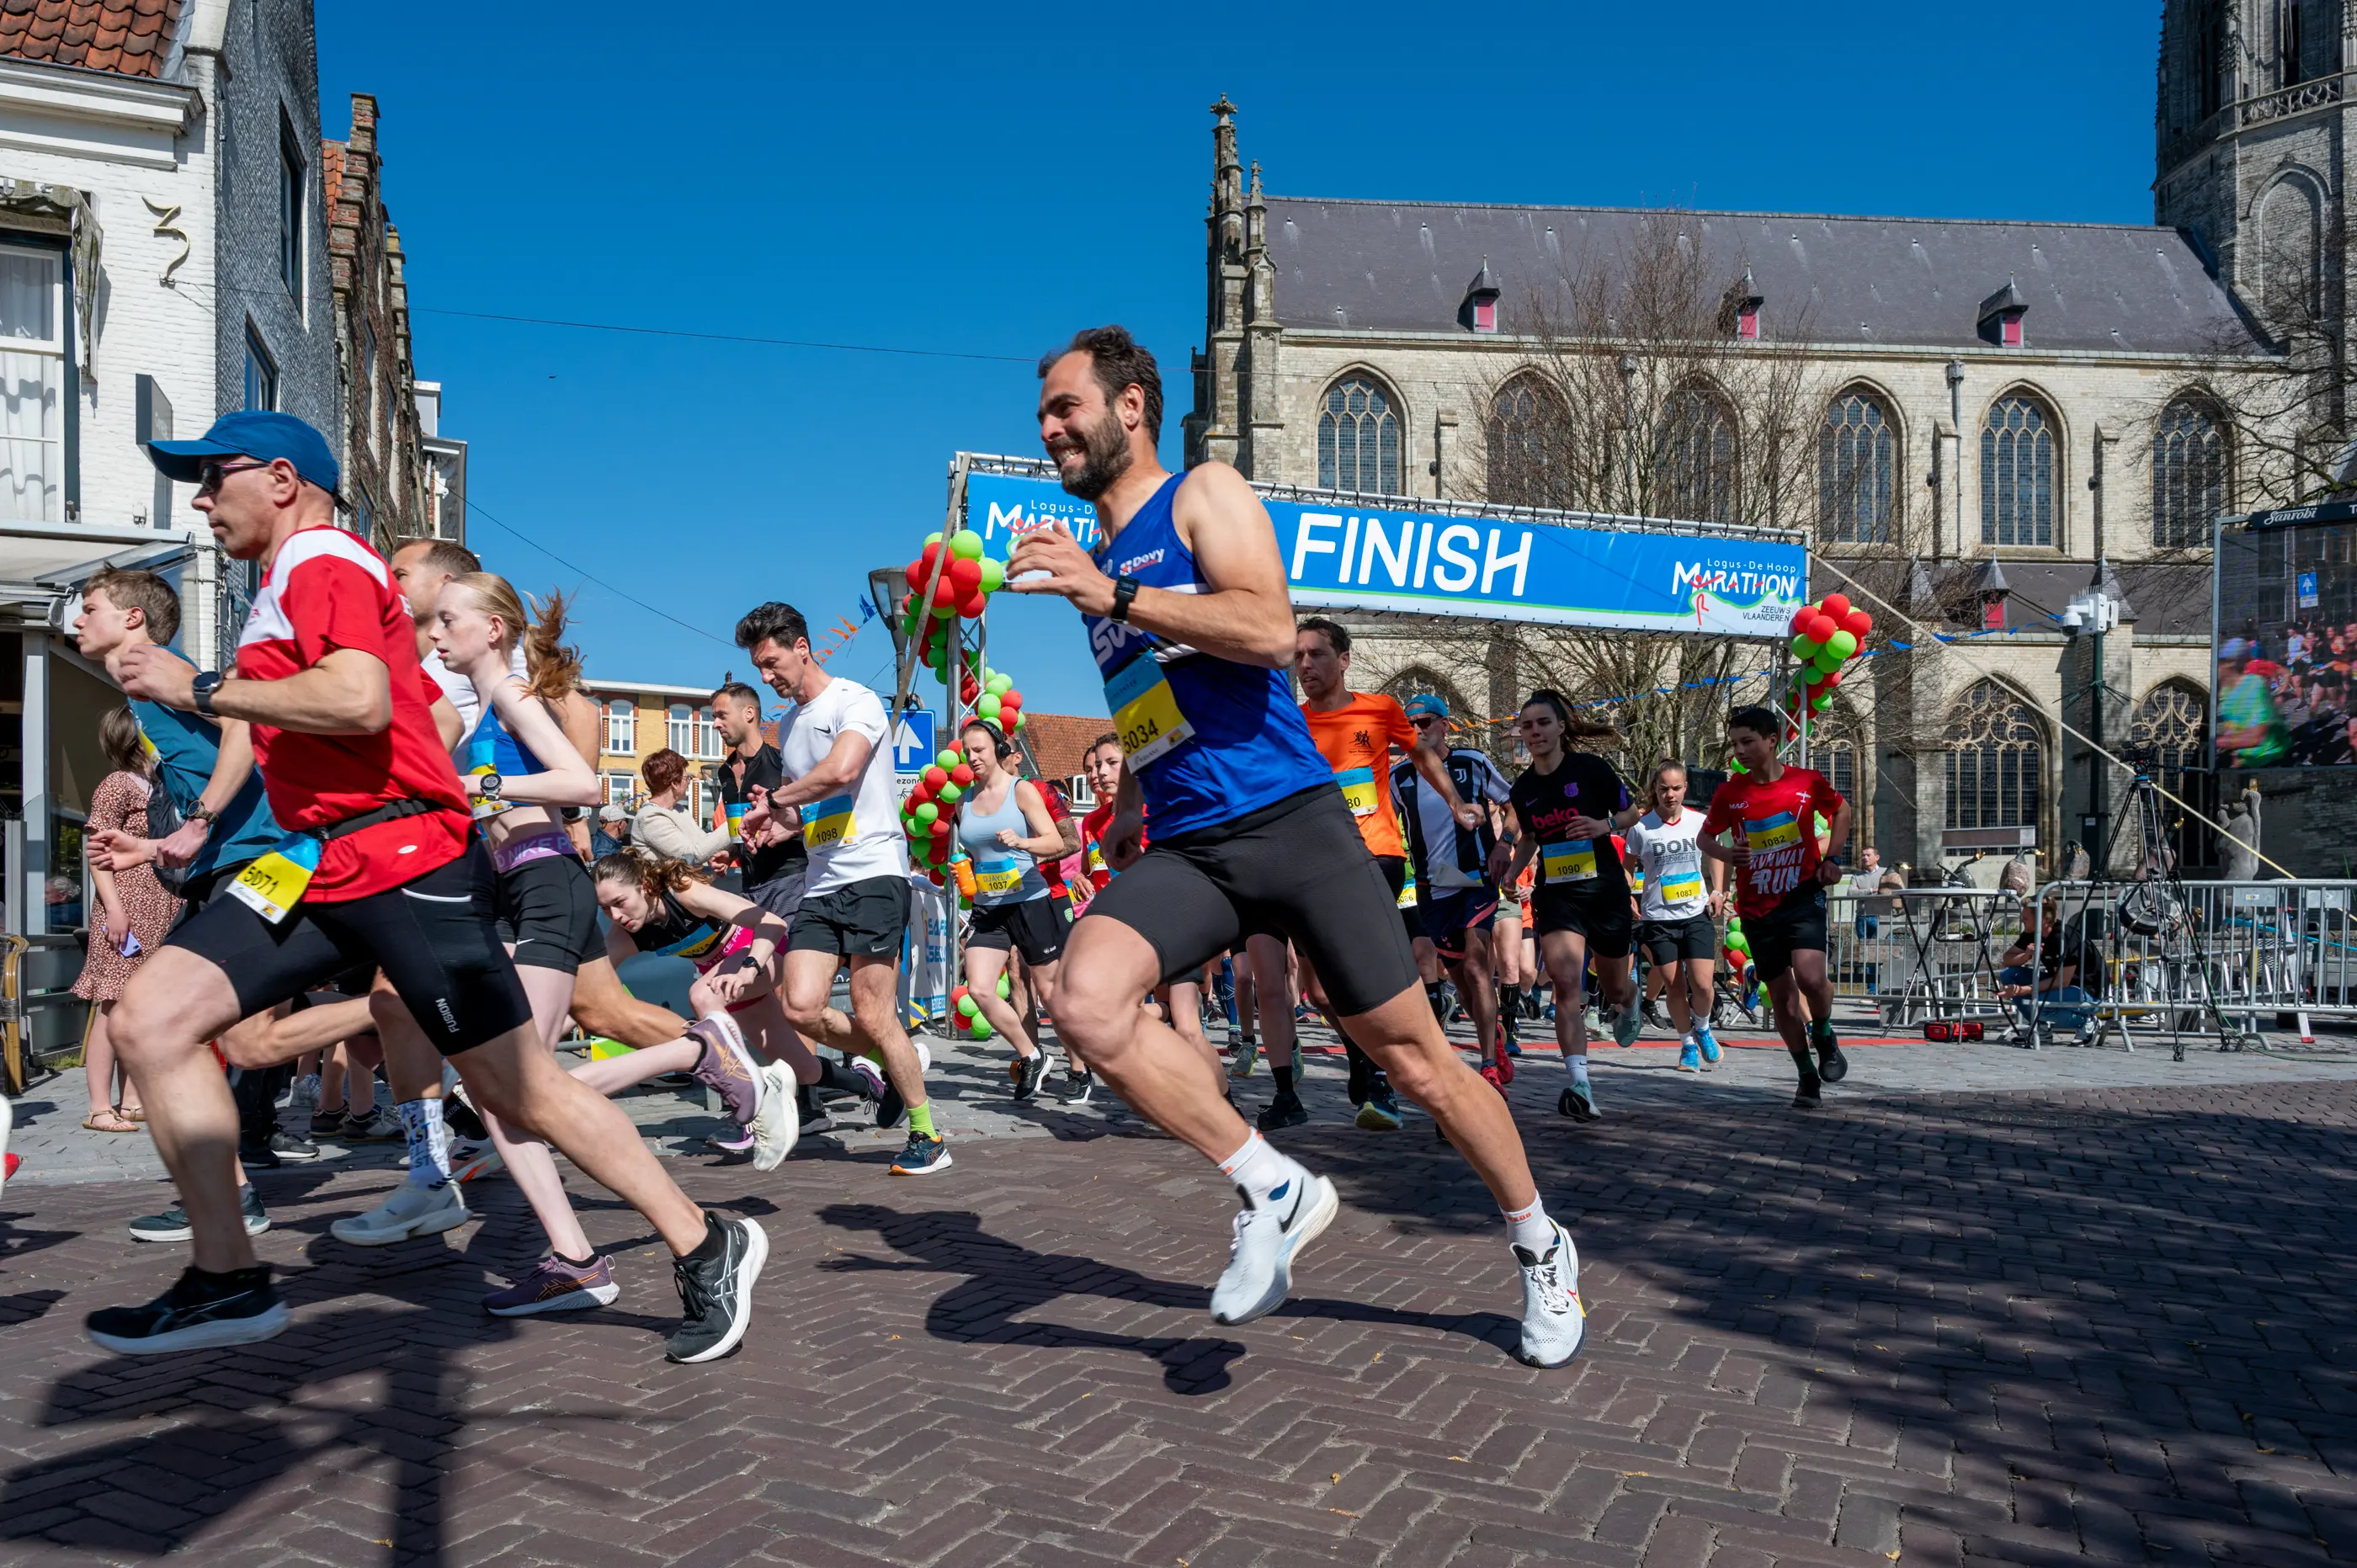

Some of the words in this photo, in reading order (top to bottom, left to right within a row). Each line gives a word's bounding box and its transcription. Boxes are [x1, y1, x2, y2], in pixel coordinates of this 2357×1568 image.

[1031, 500, 1097, 514] Logus-D
[985, 502, 1102, 543] MARATH
[1290, 512, 1533, 597] FINISH
[1767, 562, 1796, 573] Hoop
[1671, 561, 1796, 598] MARATHON
[1742, 612, 1790, 622] VLAANDEREN
[1761, 605, 1791, 614] ZEEUWS
[1122, 718, 1159, 754] 5034
[1347, 797, 1361, 808] 80
[1531, 808, 1580, 829] beko
[816, 828, 838, 843] 1098
[1762, 835, 1786, 848] 1082
[1652, 837, 1696, 858] DON
[1750, 848, 1806, 870] RUNWAY
[1556, 864, 1580, 875] 1090
[243, 866, 279, 896] 5071
[983, 874, 1012, 883] DJAYLA
[989, 881, 1008, 890] 1037
[1753, 866, 1801, 895] RUN
[1676, 889, 1693, 898] 1083
[732, 925, 744, 943] PR
[434, 997, 460, 1034] FUSION
